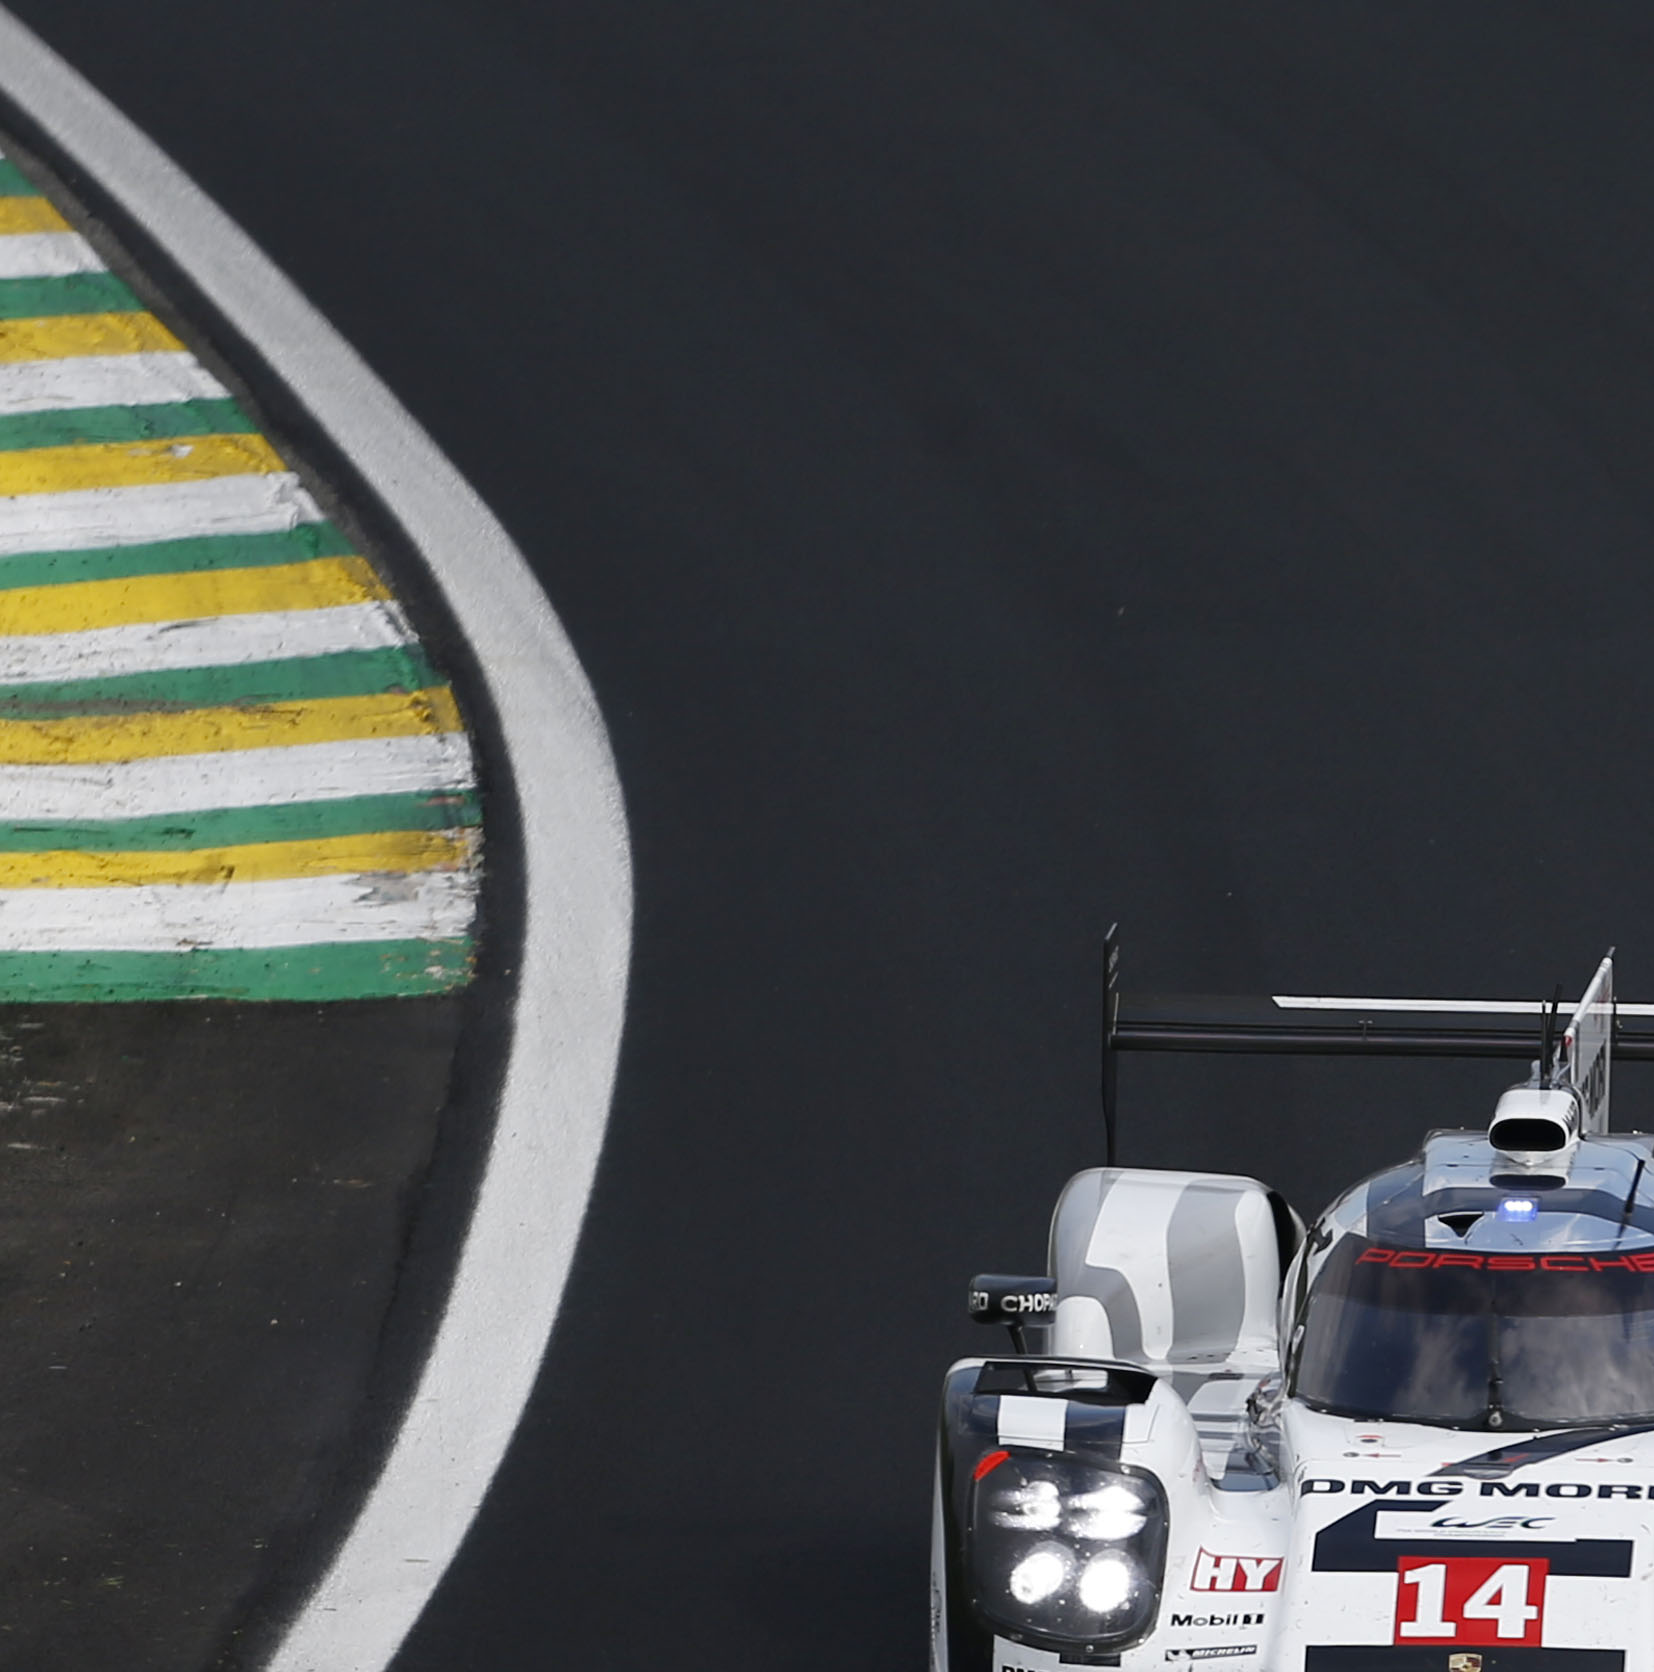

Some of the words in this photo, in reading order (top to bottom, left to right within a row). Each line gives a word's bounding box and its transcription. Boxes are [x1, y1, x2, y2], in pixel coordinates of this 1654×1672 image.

[1300, 1478, 1464, 1499] DMG
[1192, 1549, 1282, 1591] HY
[1400, 1562, 1539, 1639] 14
[1170, 1612, 1239, 1627] Mobil
